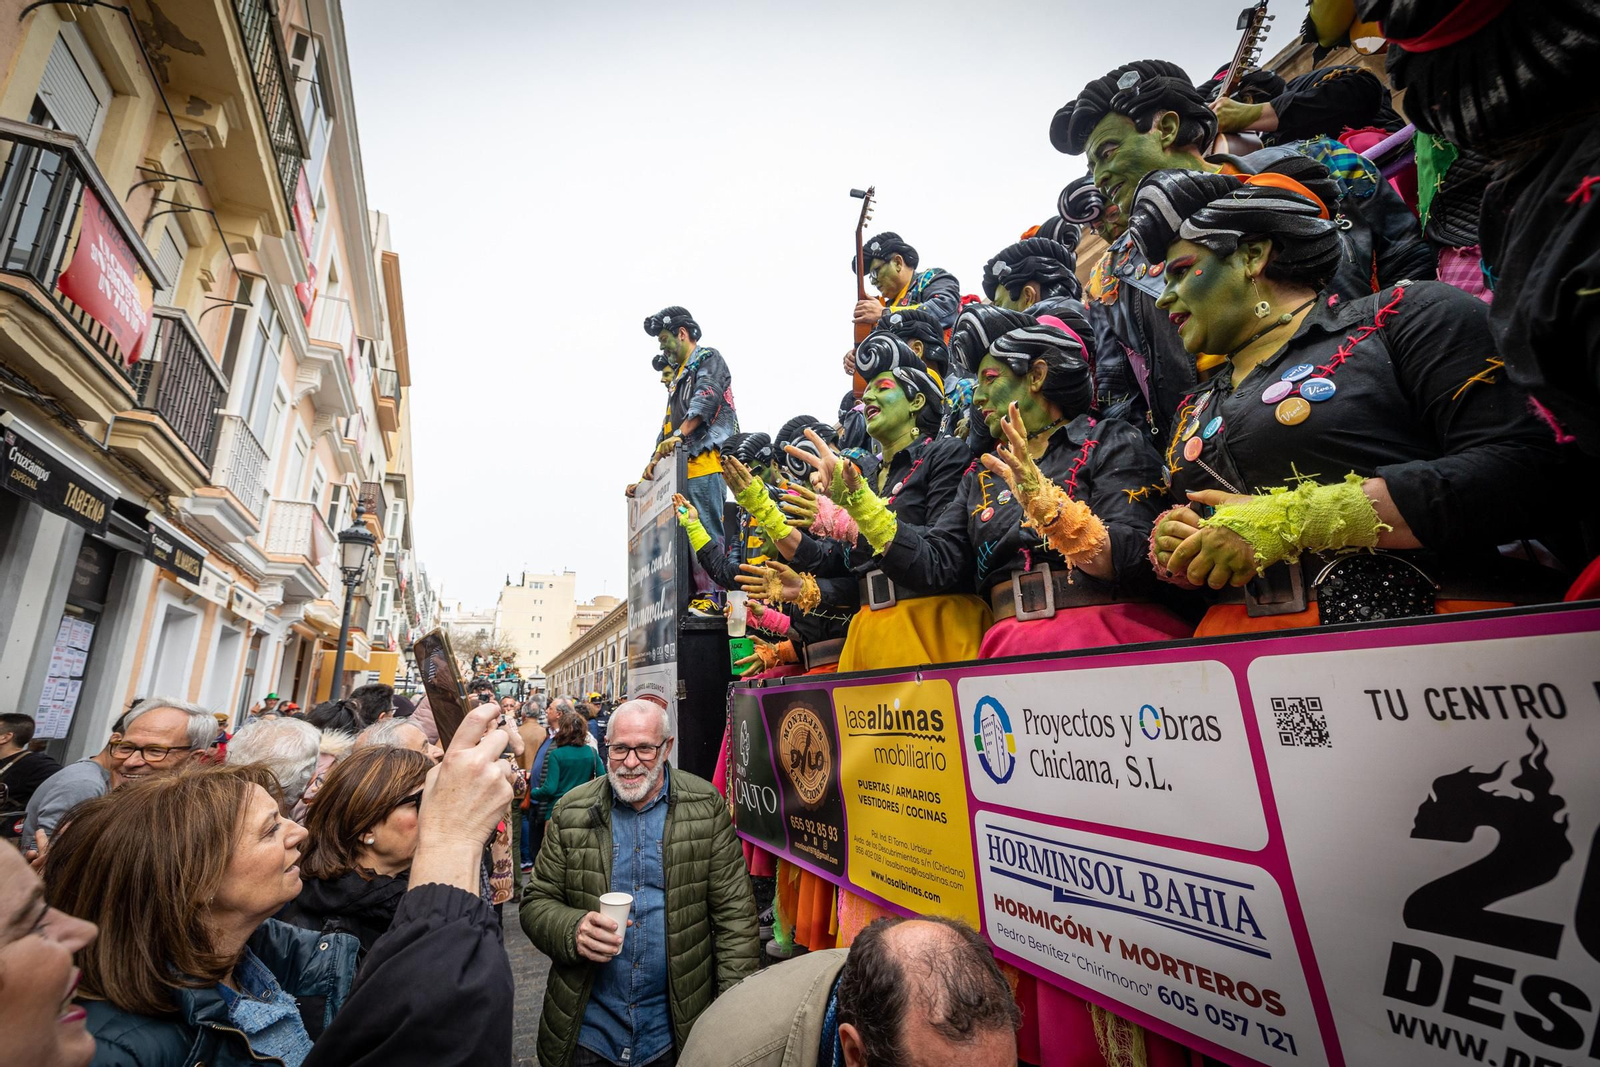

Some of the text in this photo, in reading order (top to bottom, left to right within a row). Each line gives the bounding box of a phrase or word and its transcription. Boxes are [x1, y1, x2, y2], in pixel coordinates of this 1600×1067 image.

[9, 446, 51, 481] Cruzcampo
[10, 468, 38, 490] ESPECIAL
[63, 482, 106, 524] TABERNA
[629, 564, 650, 588] Siempre
[650, 555, 663, 574] con
[664, 540, 673, 567] el
[843, 697, 944, 733] lasalbinas
[1363, 688, 1409, 721] TU
[1423, 682, 1568, 721] CENTRO
[784, 713, 824, 742] MONTAJES
[1022, 703, 1223, 748] Proyectos y Obras
[790, 730, 825, 776] DYLO
[873, 743, 947, 772] mobiliario
[1030, 749, 1173, 792] Chiclana, S.L.
[735, 777, 777, 816] CAUTO
[789, 768, 828, 800] CREACIONES
[857, 779, 891, 795] PUERTAS
[895, 786, 942, 804] ARMARIOS
[857, 794, 900, 813] VESTIDORES
[905, 805, 948, 824] COCINAS
[790, 815, 838, 842] 655 92 85 93
[878, 843, 920, 865] Descubrimientos
[920, 858, 932, 868] s/n
[932, 860, 966, 880] (Chiclana)
[910, 843, 933, 855] Urbisur
[870, 869, 941, 904] www.lasalbinas.com
[885, 858, 965, 892] lasalbinas@lasalbinas.com
[986, 833, 1268, 941] HORMINSOL BAHIA
[993, 893, 1287, 1018] HORMIGÓN Y MORTEROS
[996, 922, 1026, 946] Pedro
[1028, 934, 1071, 965] Benítez
[1157, 984, 1199, 1018] 605
[1204, 1003, 1249, 1037] 057
[1256, 1022, 1298, 1057] 121
[1382, 941, 1600, 1060] DES
